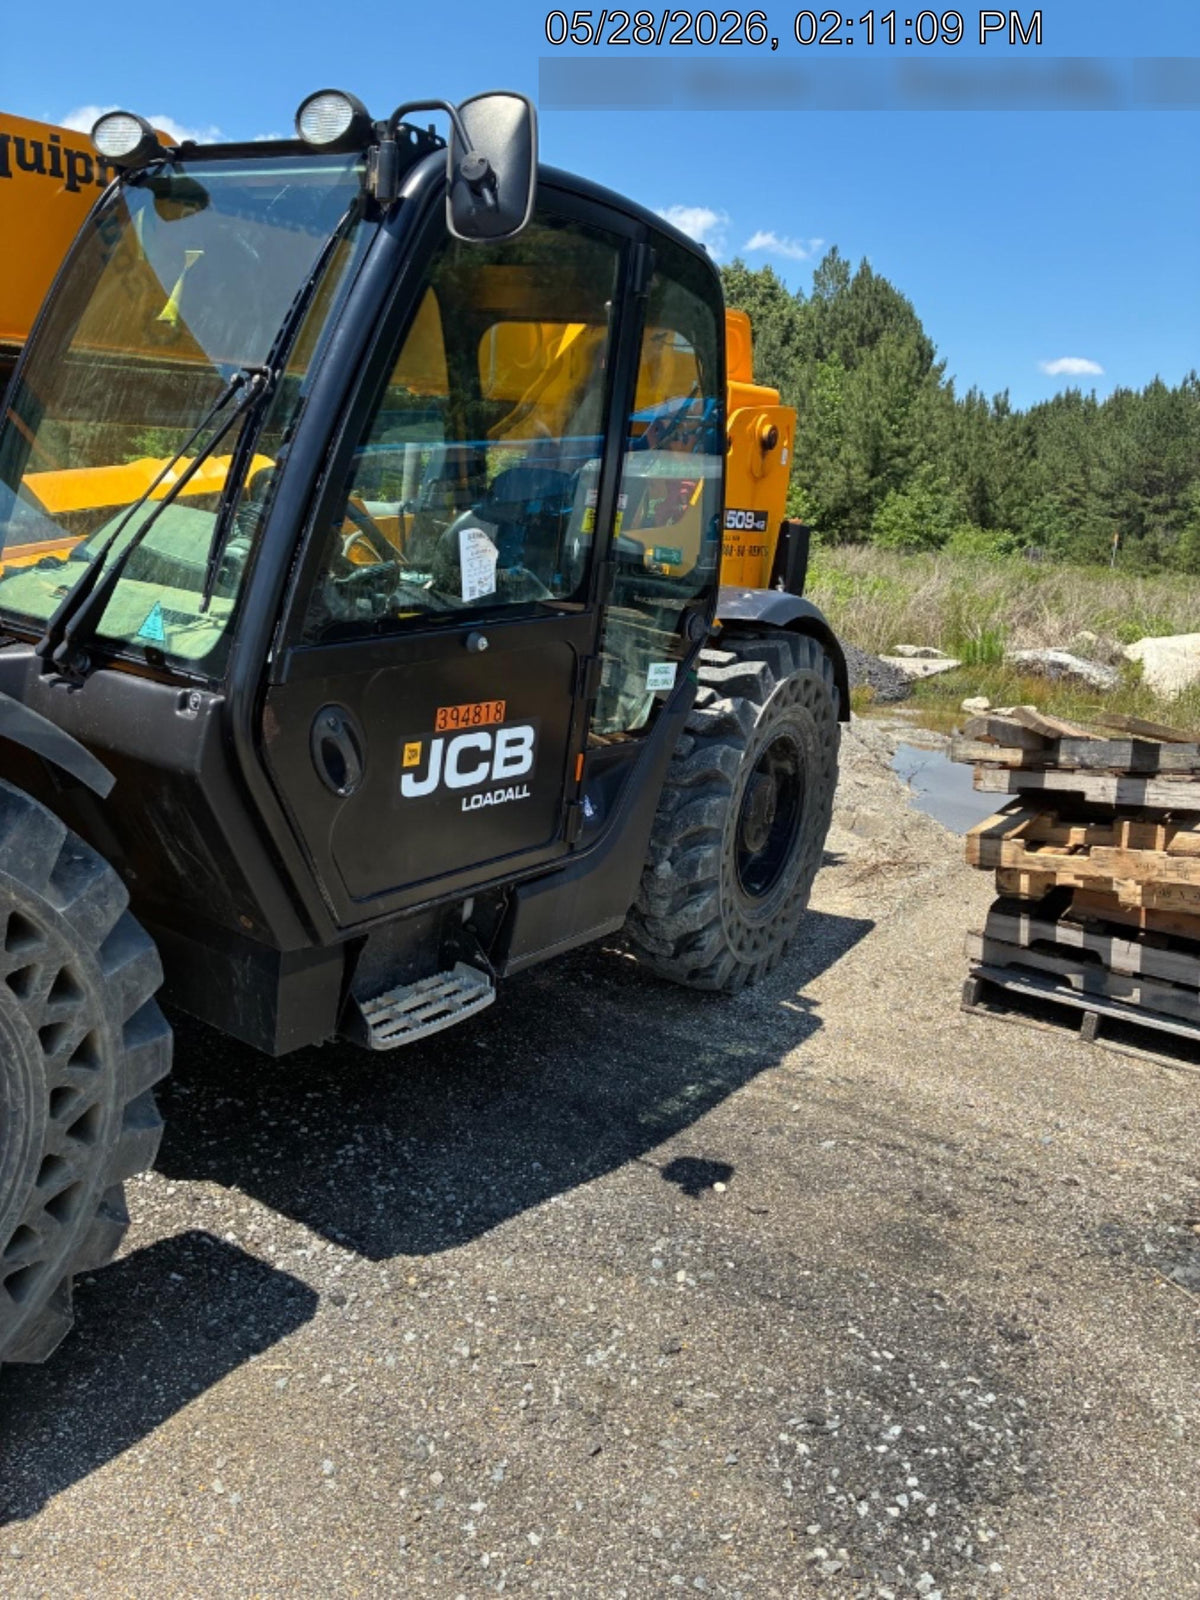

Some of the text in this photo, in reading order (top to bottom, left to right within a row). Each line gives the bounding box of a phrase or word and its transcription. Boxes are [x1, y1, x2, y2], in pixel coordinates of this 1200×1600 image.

[438, 701, 505, 731] 394818
[401, 724, 535, 798] JCB
[461, 784, 531, 812] LOADALL
